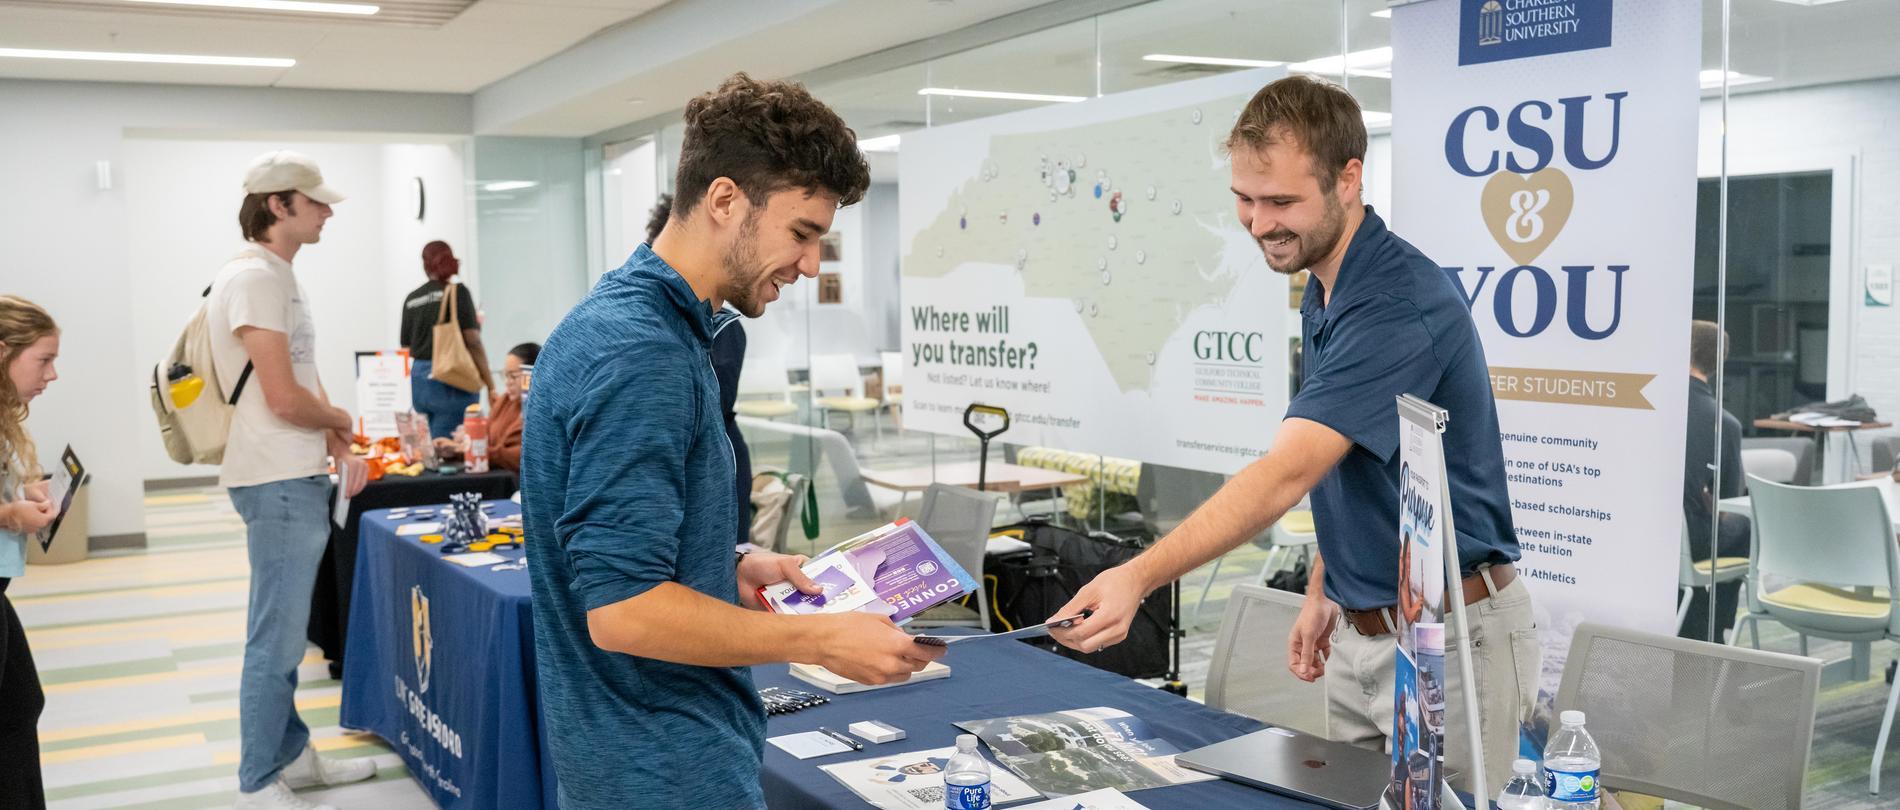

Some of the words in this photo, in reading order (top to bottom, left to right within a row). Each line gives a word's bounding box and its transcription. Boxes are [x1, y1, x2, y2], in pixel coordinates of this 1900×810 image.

[1505, 3, 1576, 27] SOUTHERN
[1505, 19, 1580, 42] UNIVERSITY
[1444, 91, 1628, 177] CSU
[1505, 189, 1550, 243] &
[1441, 264, 1630, 341] YOU
[911, 305, 970, 333] Where
[976, 305, 1009, 334] will
[912, 342, 944, 367] you
[950, 340, 1038, 370] transfer?
[1193, 330, 1264, 363] GTCC
[927, 372, 941, 383] Not
[943, 373, 968, 386] listed?
[969, 375, 982, 388] Let
[984, 379, 994, 389] us
[996, 377, 1019, 391] know
[1021, 379, 1051, 394] where!
[1523, 376, 1616, 398] STUDENTS
[1014, 412, 1081, 430] gtcc.edu/transfer
[1176, 439, 1269, 458] transferservices@gtcc.ed
[1541, 436, 1598, 451] community
[1516, 460, 1535, 470] one
[1538, 461, 1549, 471] of
[1551, 463, 1581, 475] USA's
[1583, 466, 1601, 478] top
[1506, 473, 1563, 487] estinations
[1548, 504, 1612, 521] scholarships
[1514, 527, 1551, 539] etween
[1553, 531, 1592, 546] in-state
[1539, 543, 1573, 557] tuition
[1531, 569, 1576, 584] Athletics
[882, 592, 904, 605] EC
[964, 787, 983, 796] Pure
[966, 794, 981, 804] Life
